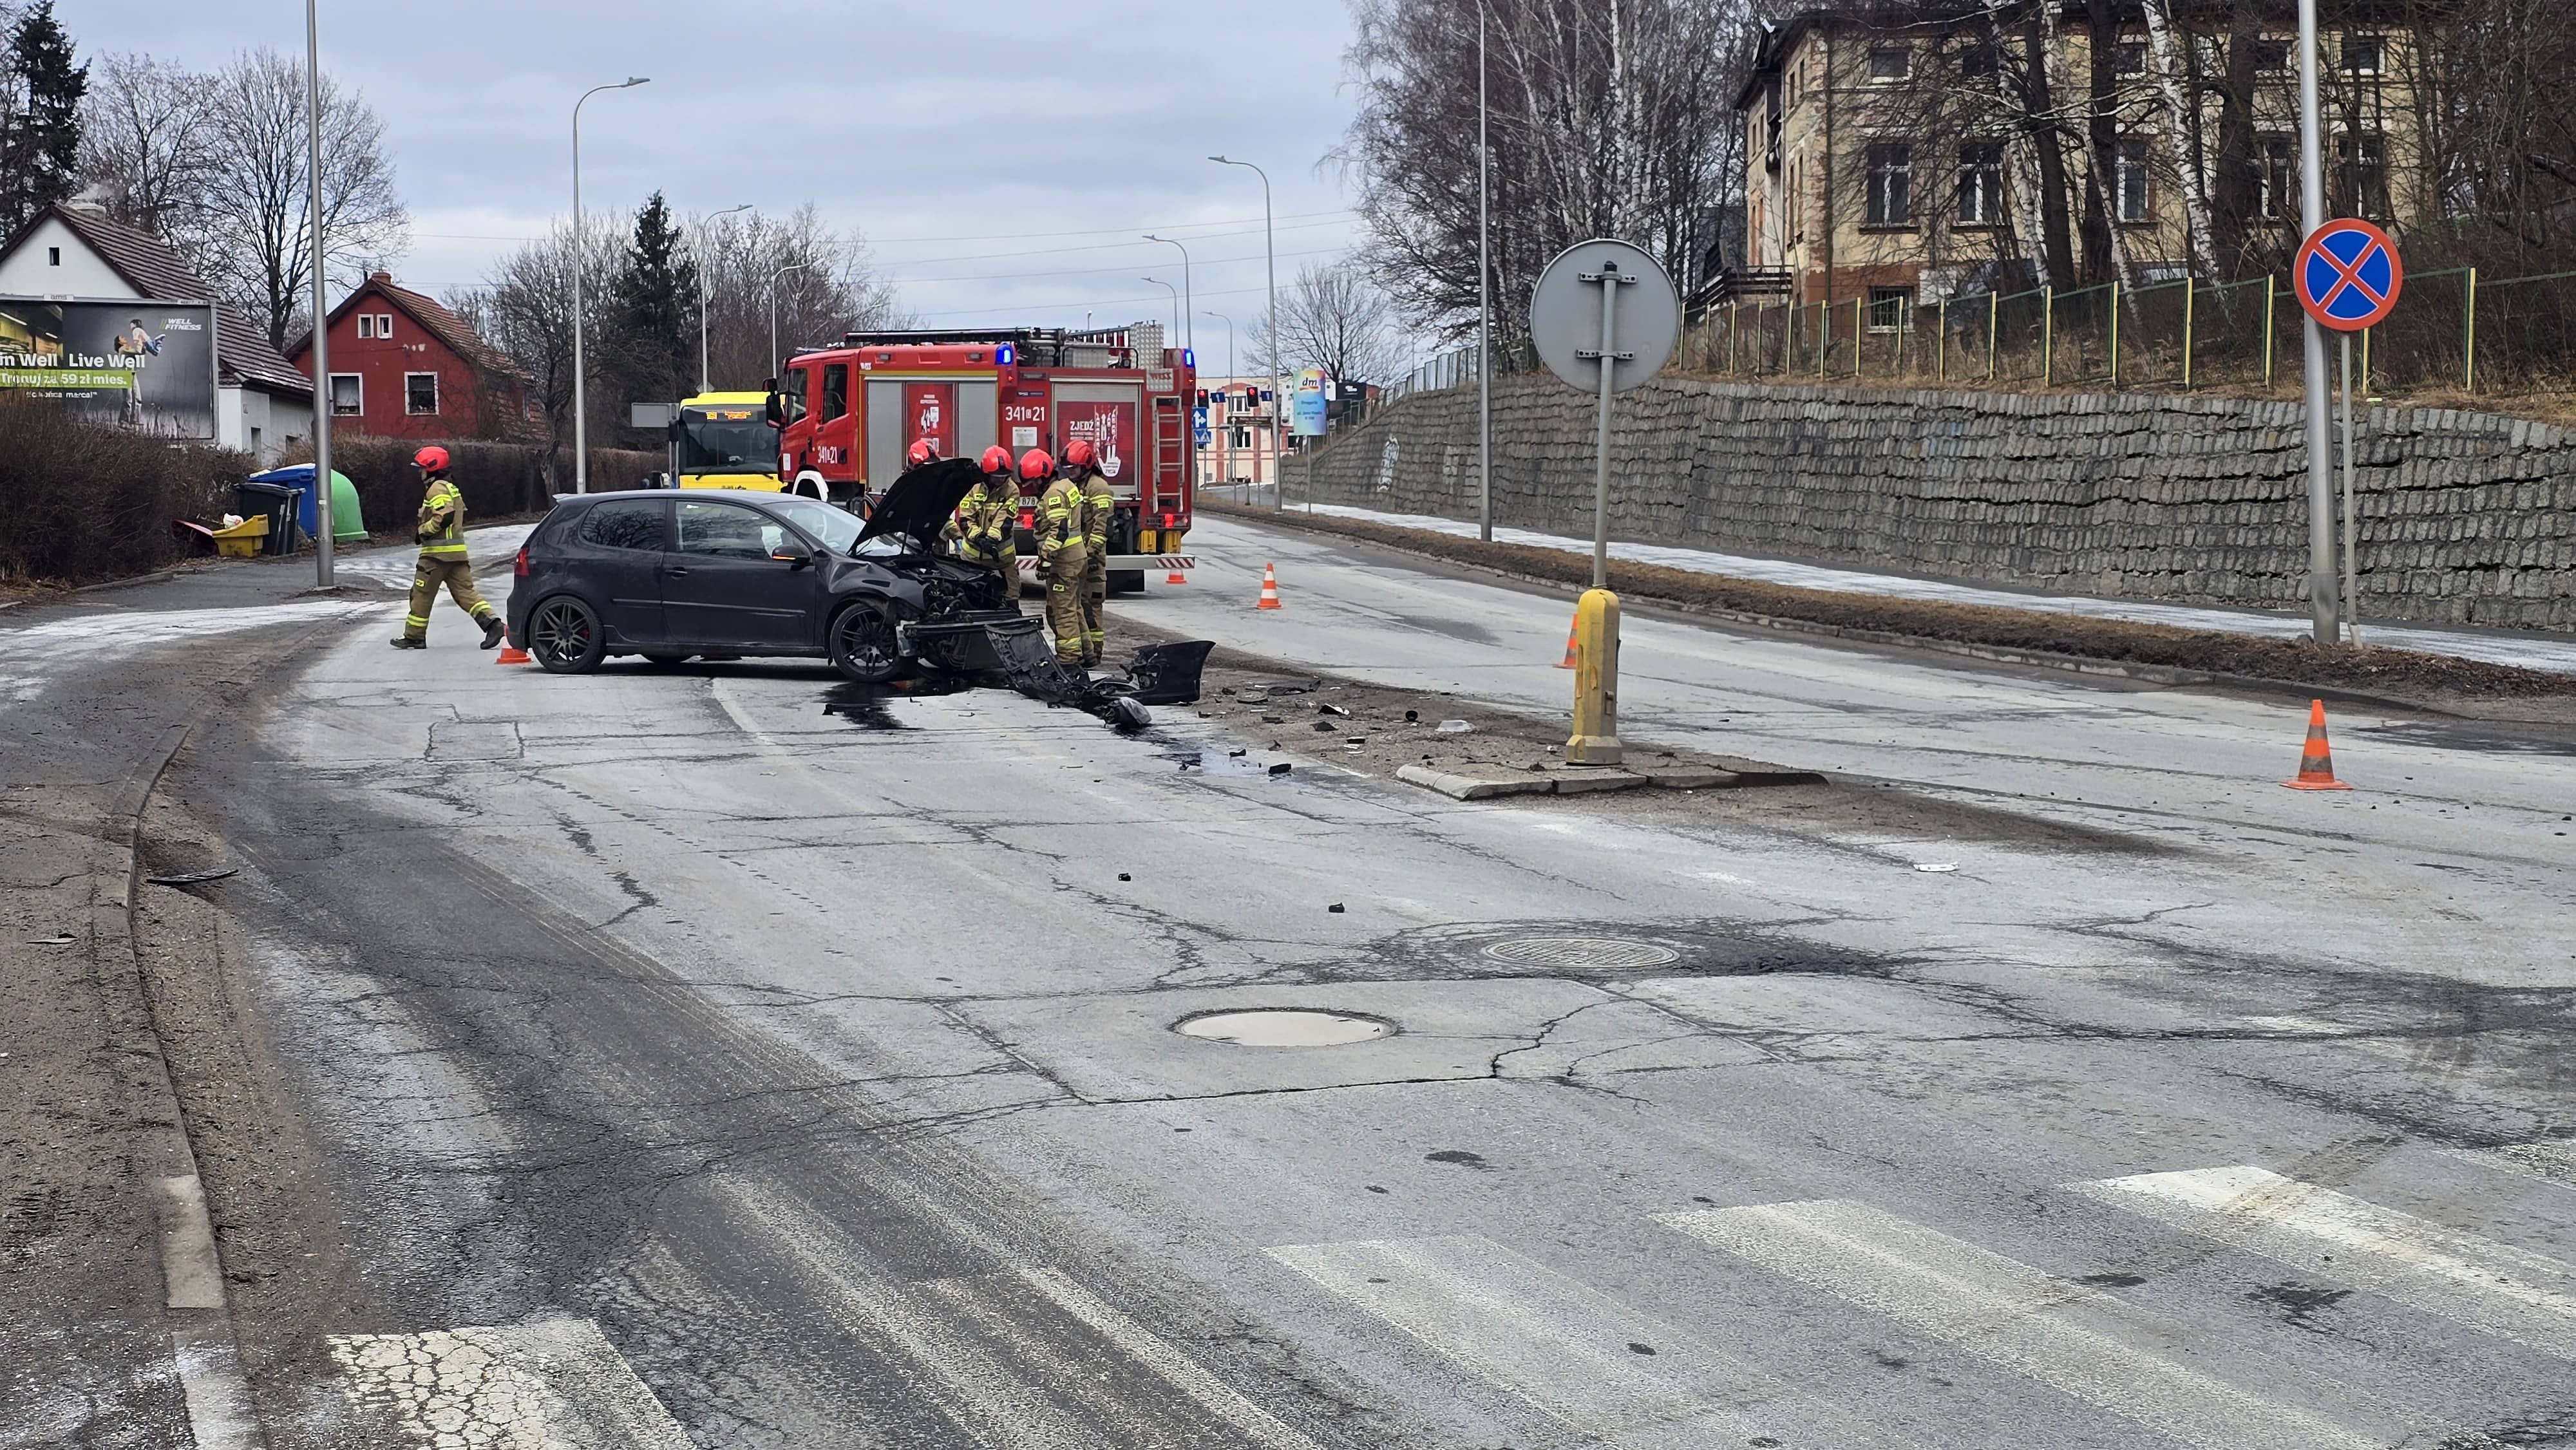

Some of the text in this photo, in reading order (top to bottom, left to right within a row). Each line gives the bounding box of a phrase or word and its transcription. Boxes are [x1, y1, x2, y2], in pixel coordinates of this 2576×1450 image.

[19, 353, 58, 367] Well
[69, 353, 104, 367] Live
[107, 353, 145, 368] Well
[61, 373, 77, 384] 59
[80, 373, 90, 384] zł
[93, 373, 128, 384] mies.
[1302, 377, 1318, 386] dm
[1070, 419, 1094, 431] ZJEDŹ
[1021, 497, 1036, 505] 878
